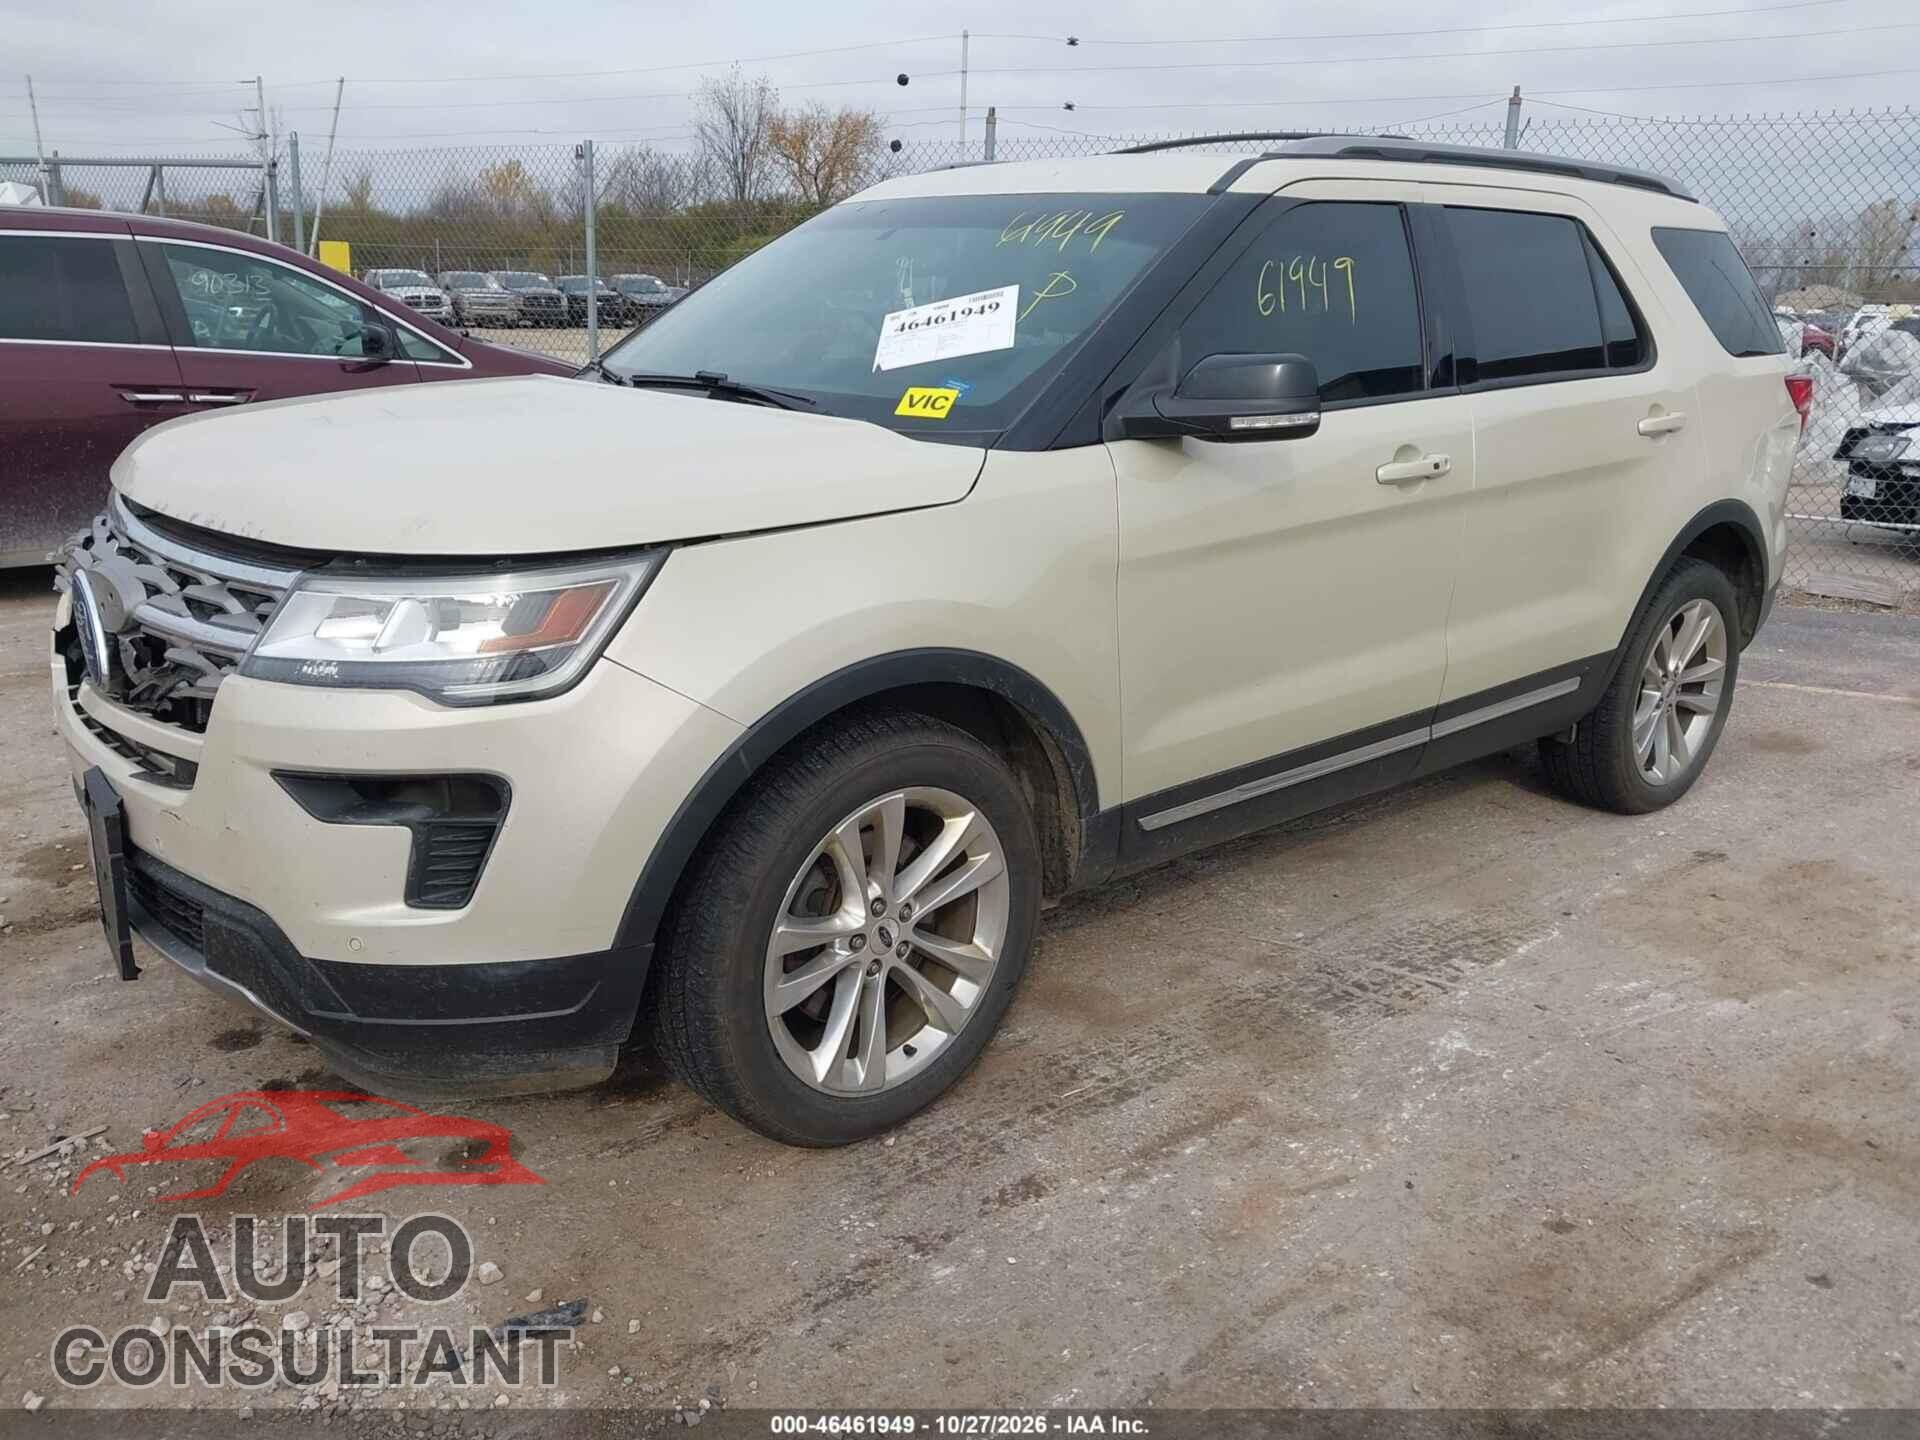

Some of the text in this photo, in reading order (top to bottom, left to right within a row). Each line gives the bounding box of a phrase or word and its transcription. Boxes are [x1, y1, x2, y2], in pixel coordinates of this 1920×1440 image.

[997, 210, 1125, 254] 61949
[1257, 255, 1356, 326] 61949
[893, 300, 1001, 334] 46461949
[907, 393, 950, 412] VIC
